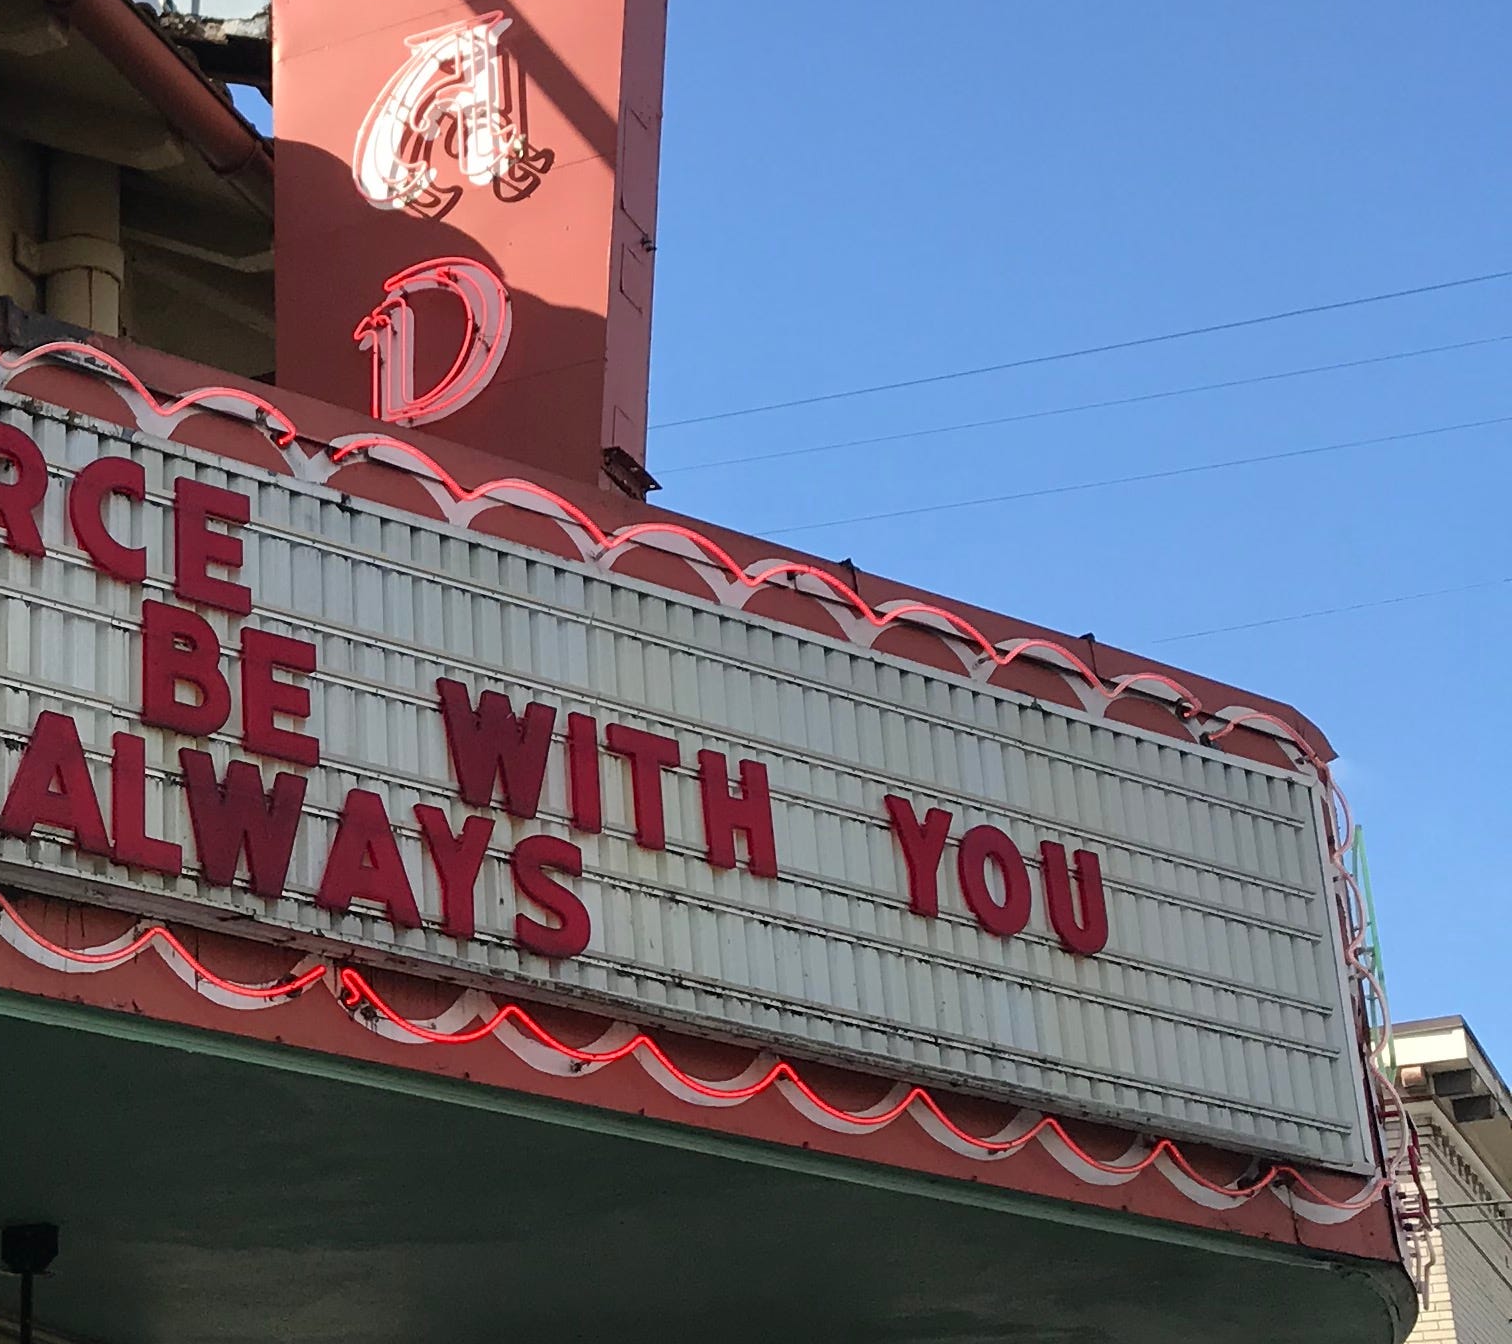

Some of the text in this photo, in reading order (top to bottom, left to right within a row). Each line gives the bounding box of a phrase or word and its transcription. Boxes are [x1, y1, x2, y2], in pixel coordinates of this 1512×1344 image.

[0, 709, 591, 960] ALWAYS
[140, 597, 321, 767] BE
[436, 676, 779, 880] WITH
[884, 793, 1110, 957] YOU
